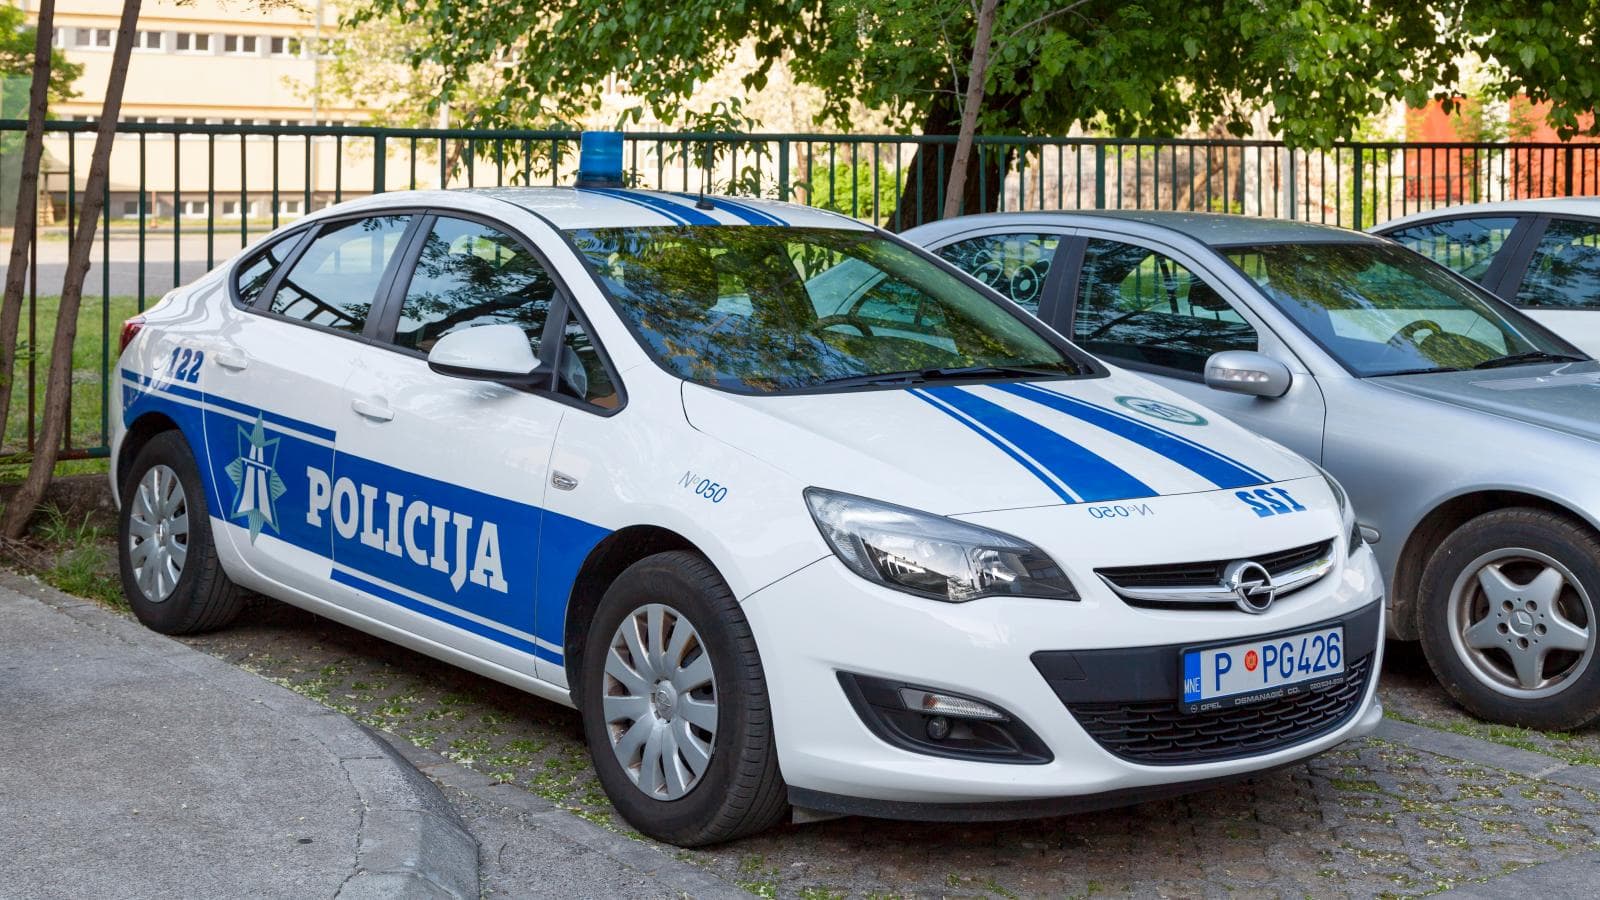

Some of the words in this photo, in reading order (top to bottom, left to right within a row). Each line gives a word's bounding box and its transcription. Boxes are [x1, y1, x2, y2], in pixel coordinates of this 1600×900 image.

[166, 346, 205, 384] 122
[306, 466, 508, 594] POLICIJA
[1184, 677, 1201, 695] MNE
[1215, 652, 1232, 692] P
[1263, 632, 1341, 683] PG426
[1201, 702, 1222, 712] OPEL
